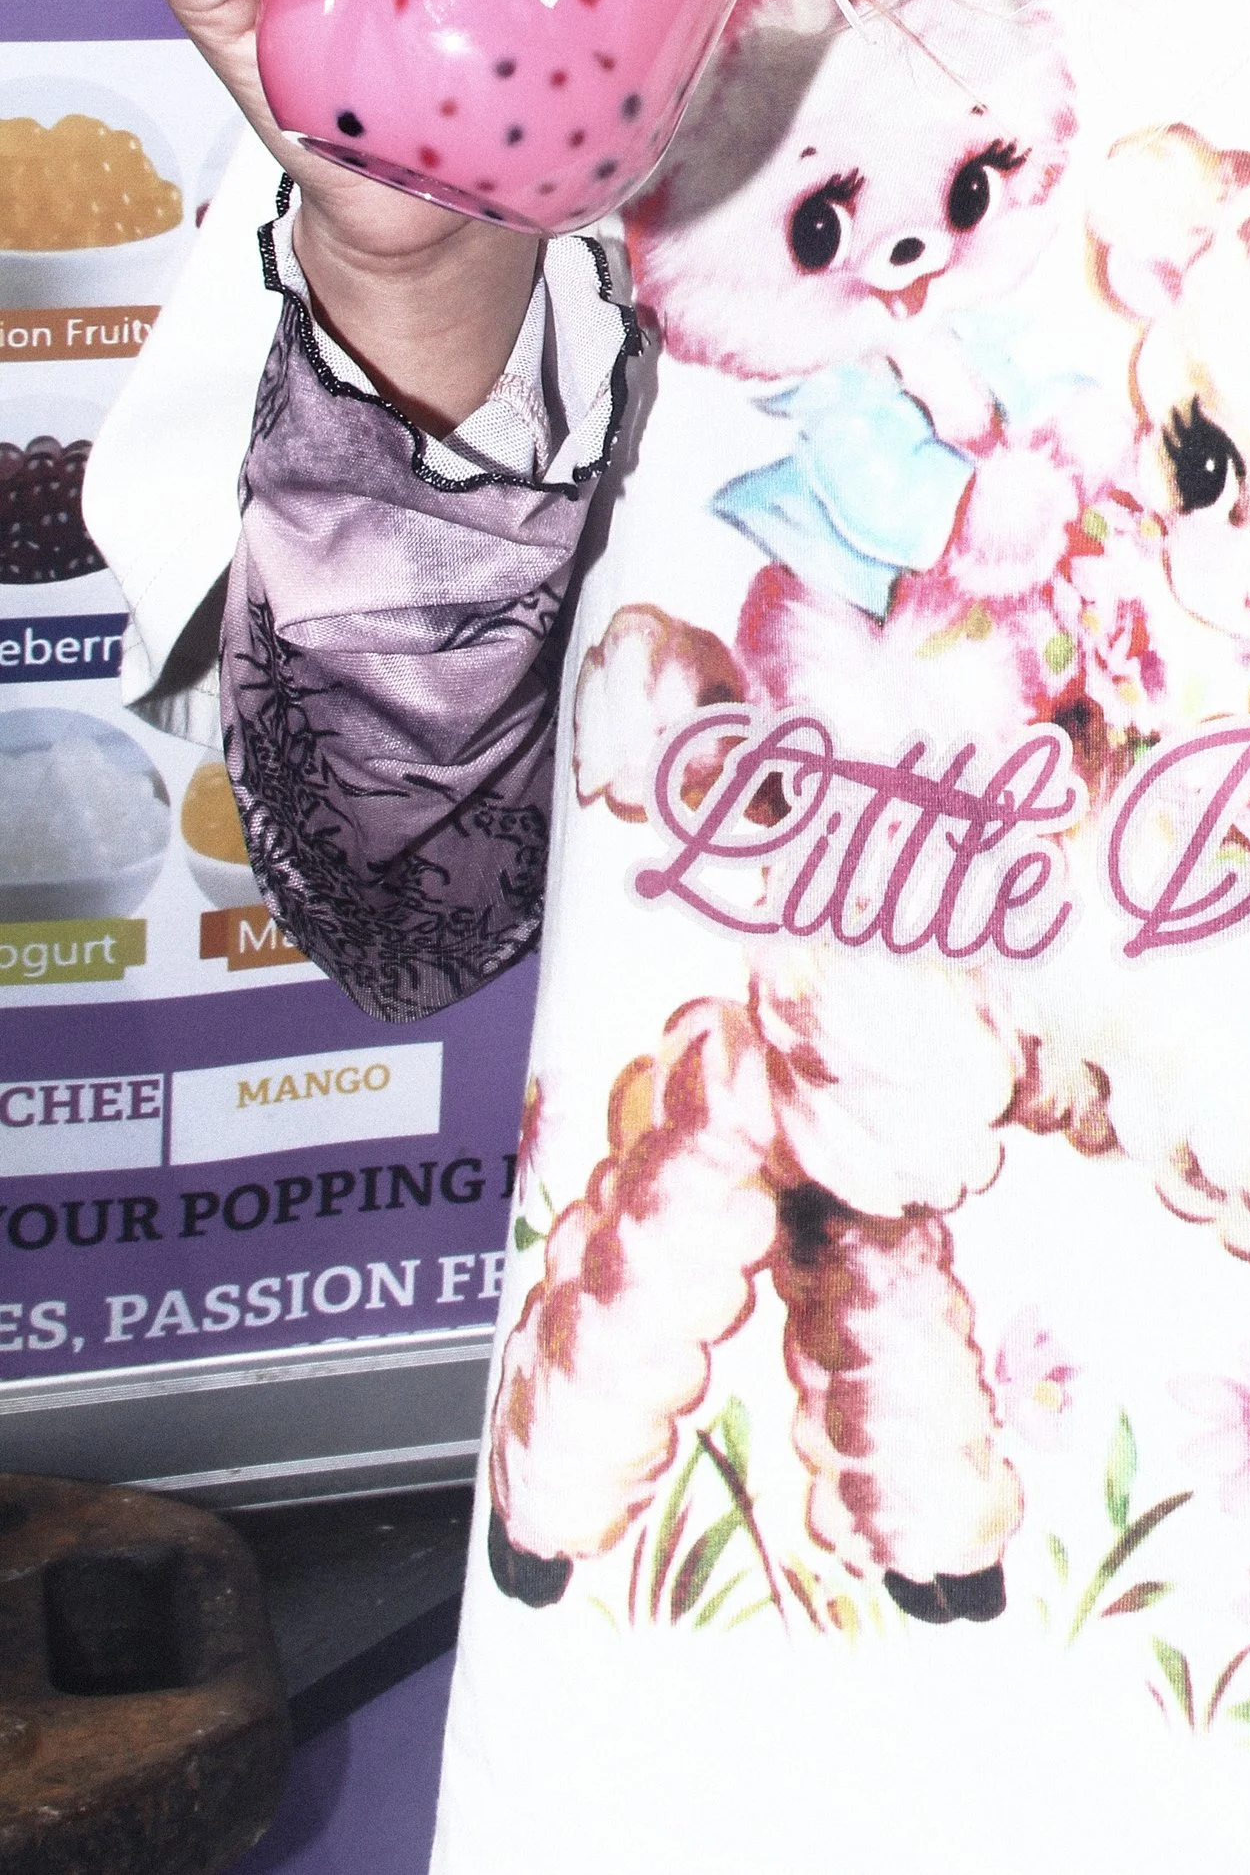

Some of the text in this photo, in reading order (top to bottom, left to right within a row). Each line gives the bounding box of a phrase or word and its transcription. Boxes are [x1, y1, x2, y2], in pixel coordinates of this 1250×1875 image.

[633, 713, 1075, 961] Little
[0, 1079, 160, 1127] CHEE
[237, 1063, 391, 1109] MANGO
[0, 1196, 160, 1250] OUR
[179, 1157, 486, 1238] POPPING
[104, 1260, 419, 1342] PASSION
